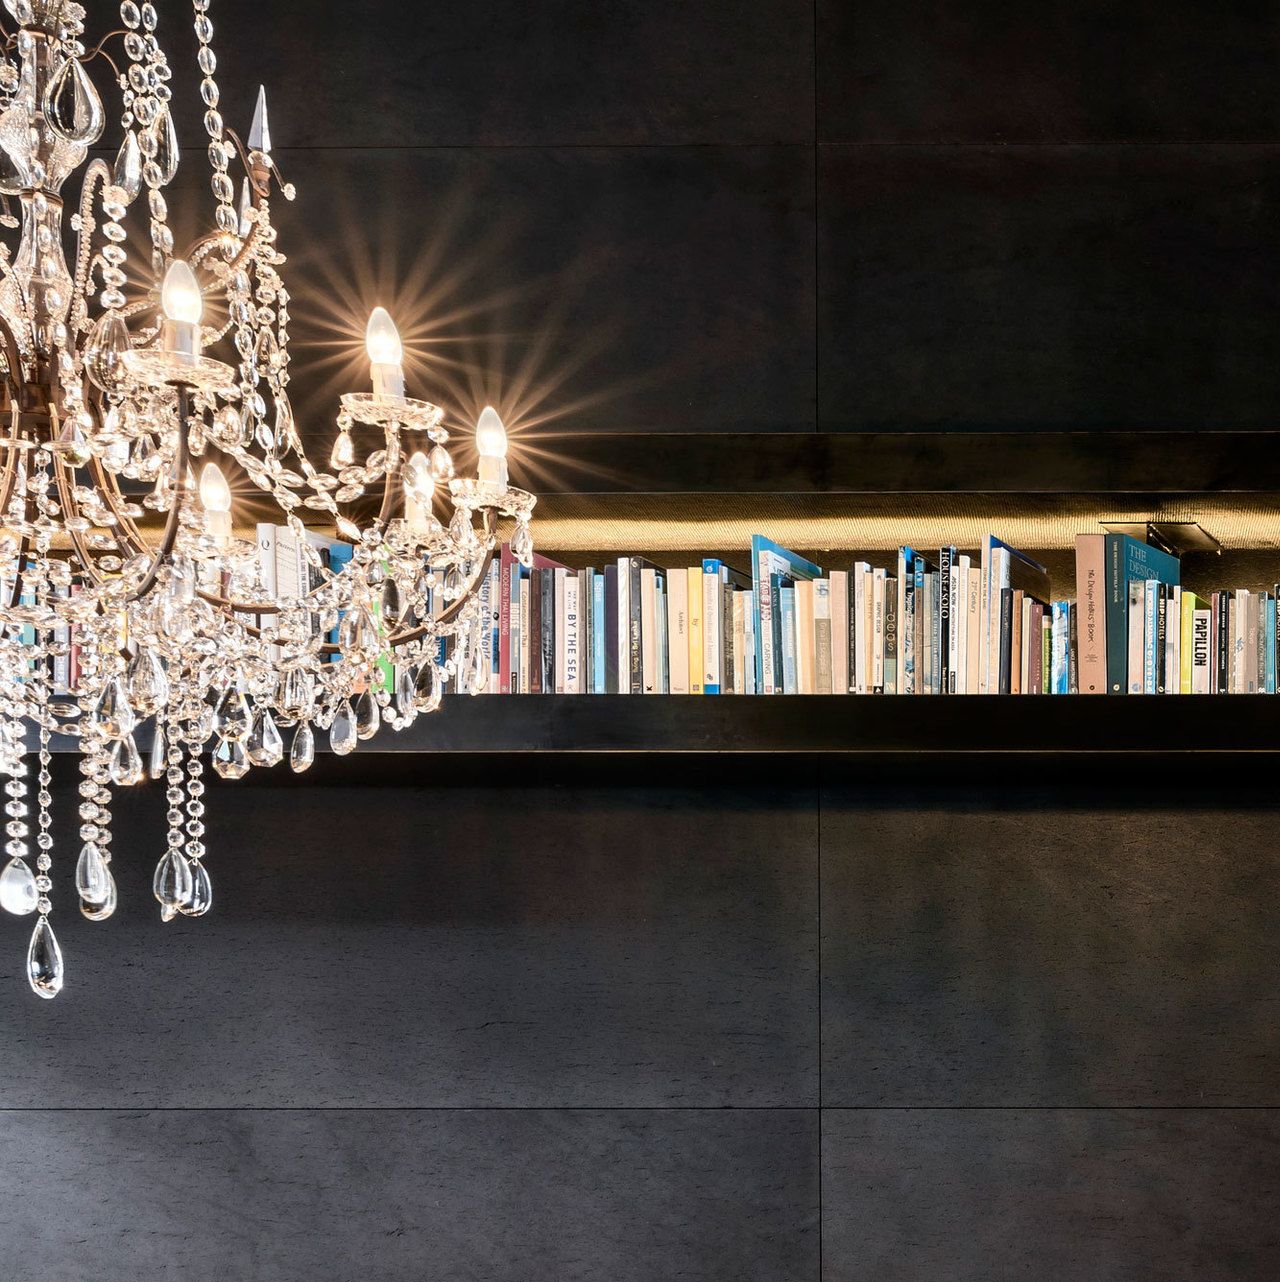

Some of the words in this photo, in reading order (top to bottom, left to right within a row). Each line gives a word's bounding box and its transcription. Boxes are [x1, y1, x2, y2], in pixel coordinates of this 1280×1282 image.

[1129, 544, 1146, 562] THE
[510, 602, 519, 629] HOUSE
[568, 614, 576, 630] BY
[568, 632, 576, 654] THE
[1194, 618, 1207, 666] PAPILLON
[568, 659, 576, 681] SEA
